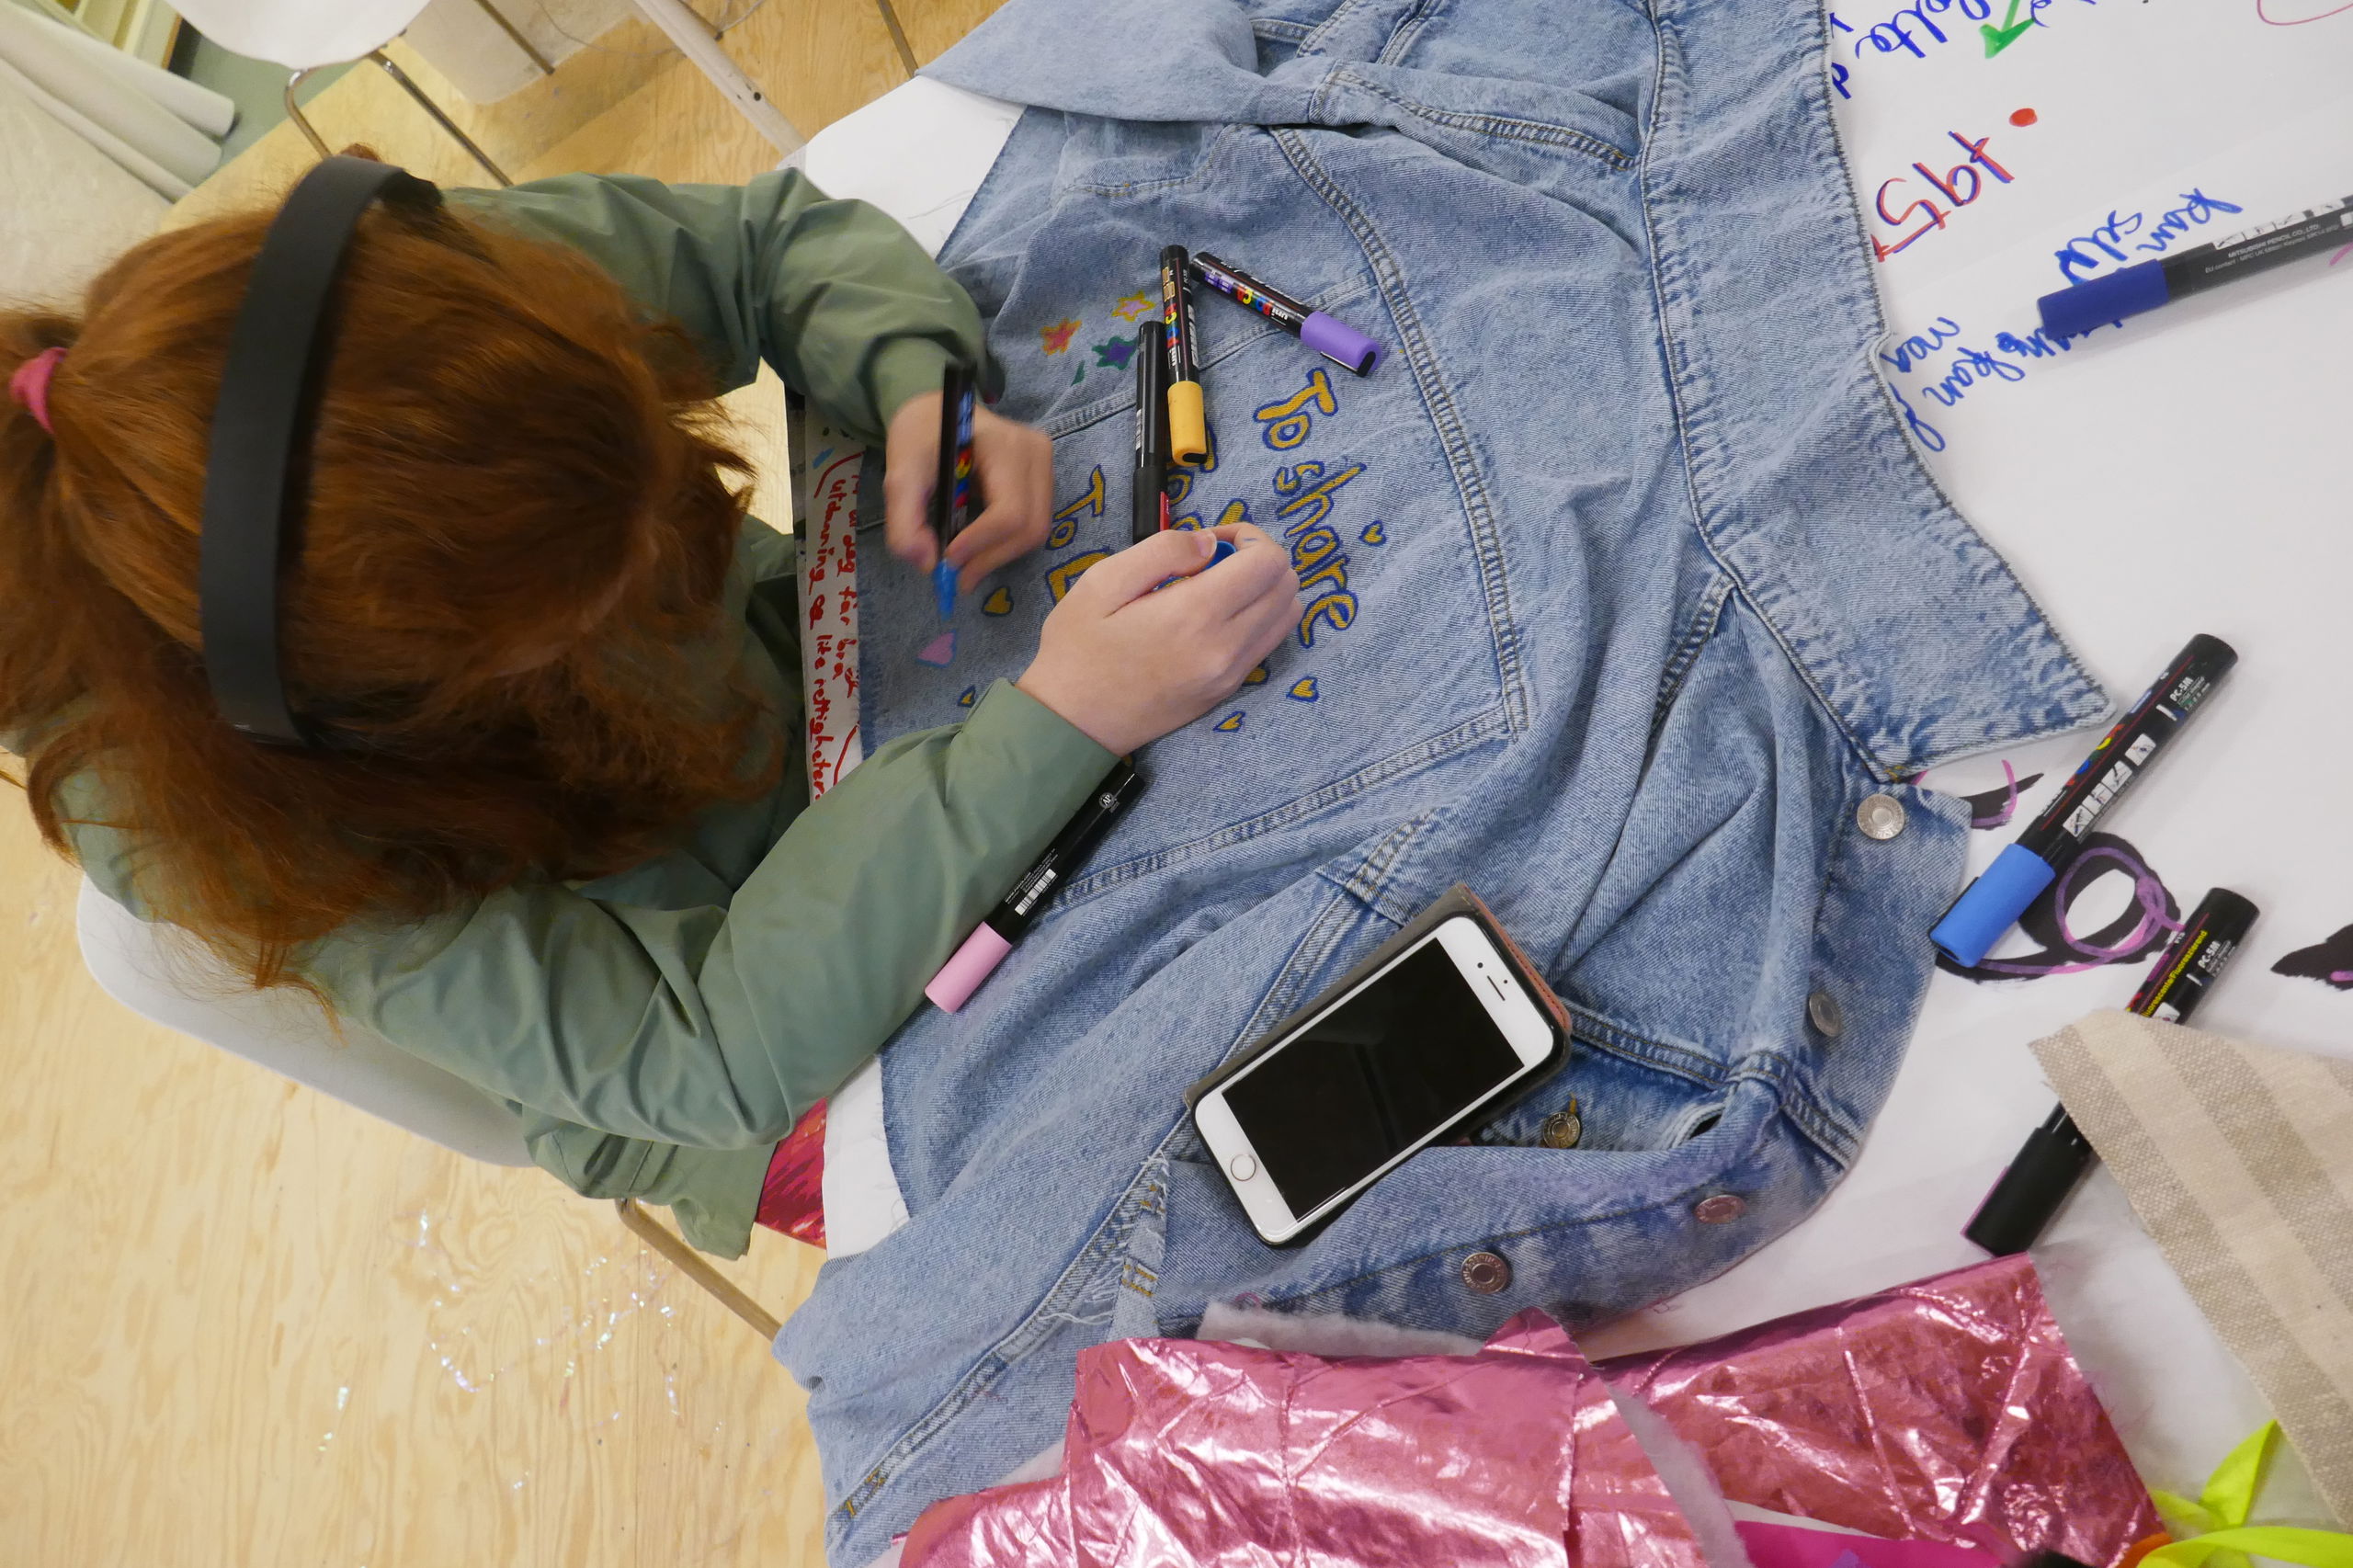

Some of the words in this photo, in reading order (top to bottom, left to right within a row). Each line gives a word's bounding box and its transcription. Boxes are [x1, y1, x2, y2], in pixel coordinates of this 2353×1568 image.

[1253, 368, 1339, 451] To
[1046, 463, 1107, 551] To
[1272, 460, 1368, 649] share
[2168, 676, 2195, 703] PC-5M
[2196, 939, 2222, 970] PC-5M
